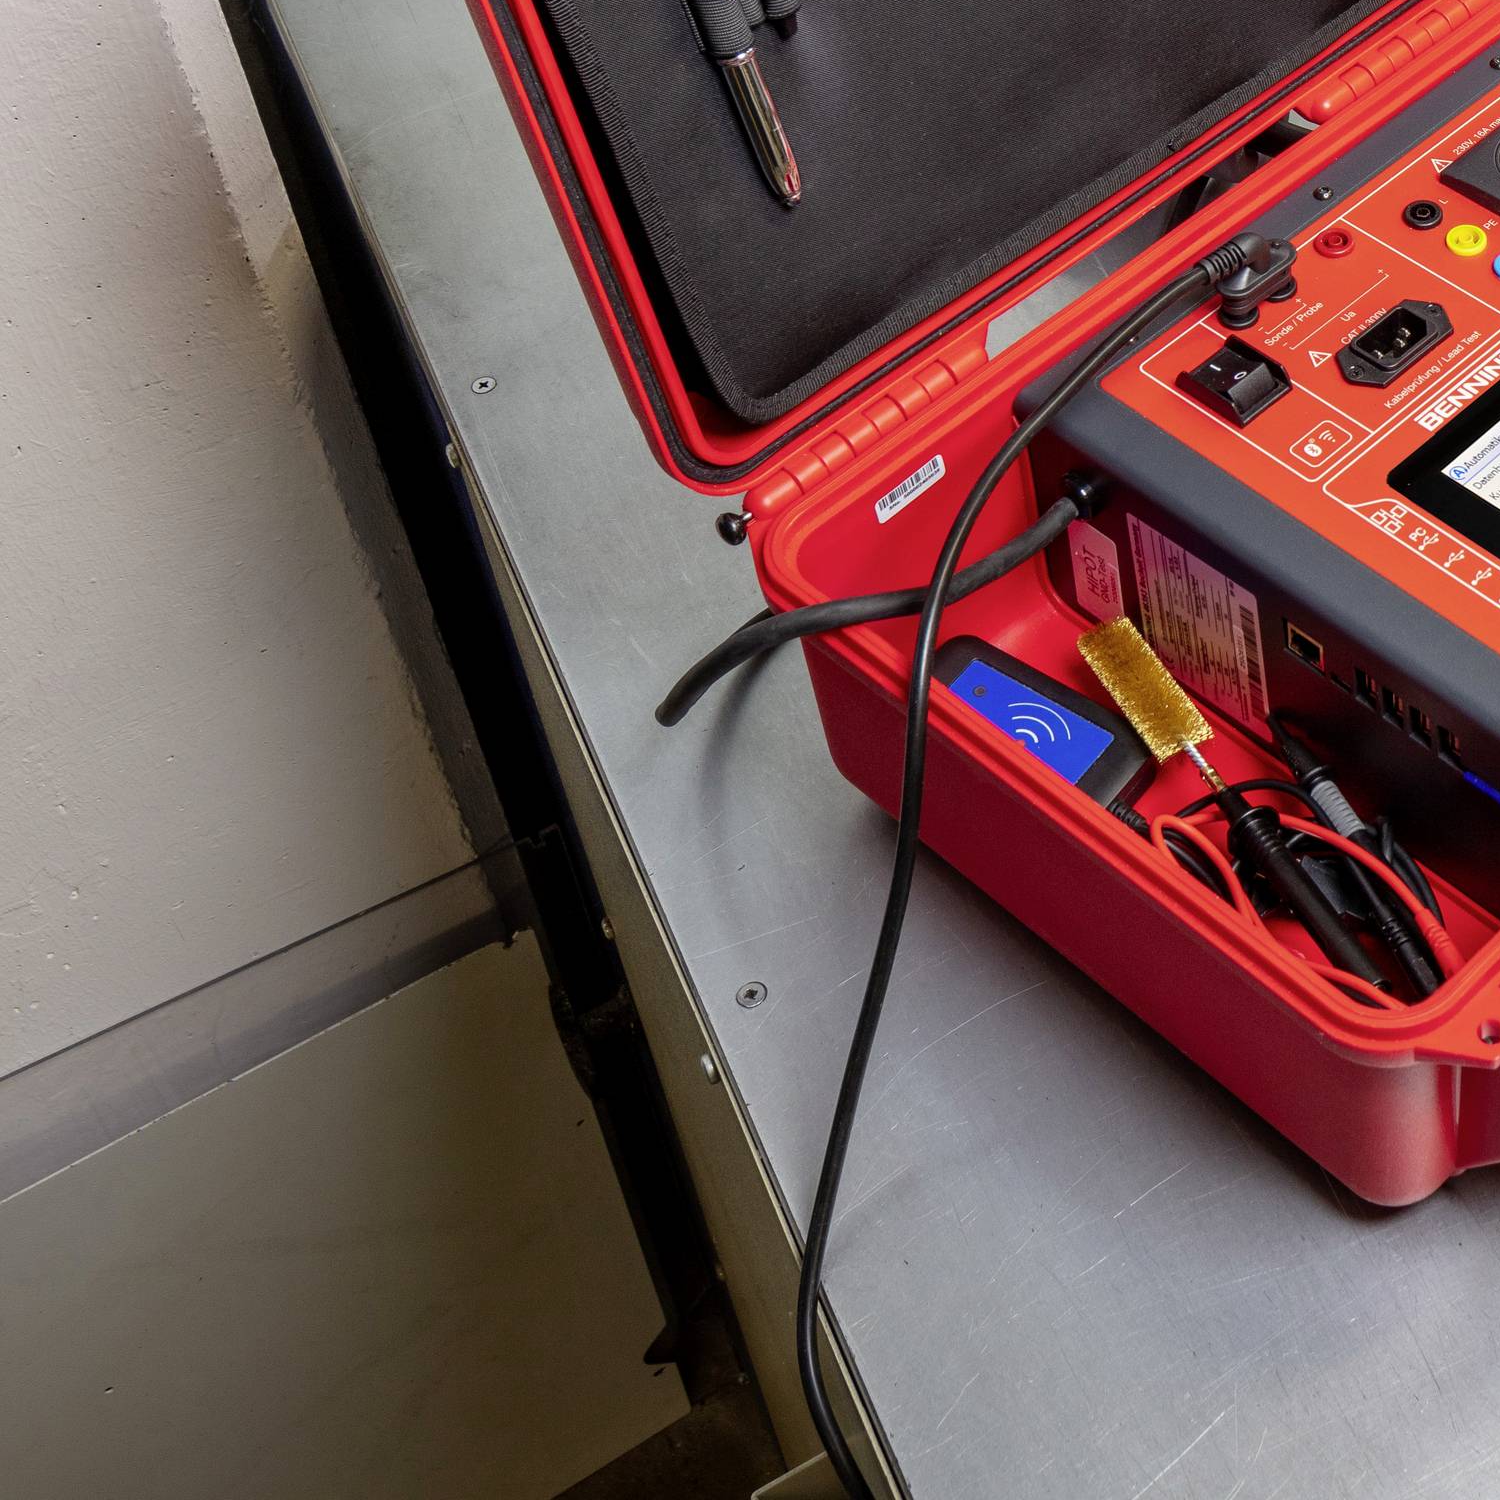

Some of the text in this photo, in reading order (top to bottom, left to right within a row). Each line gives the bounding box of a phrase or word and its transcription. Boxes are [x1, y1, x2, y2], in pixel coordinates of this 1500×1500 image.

[1452, 137, 1476, 156] 230V,
[1473, 127, 1491, 144] 16A
[1483, 218, 1498, 231] PE
[1264, 301, 1324, 347] Sonde Probe
[1341, 310, 1356, 323] Ua
[1341, 331, 1360, 345] CAT
[1383, 331, 1482, 410] Kabelprüfung Lead Test
[1408, 527, 1426, 542] PC
[1083, 545, 1099, 597] HIPOT
